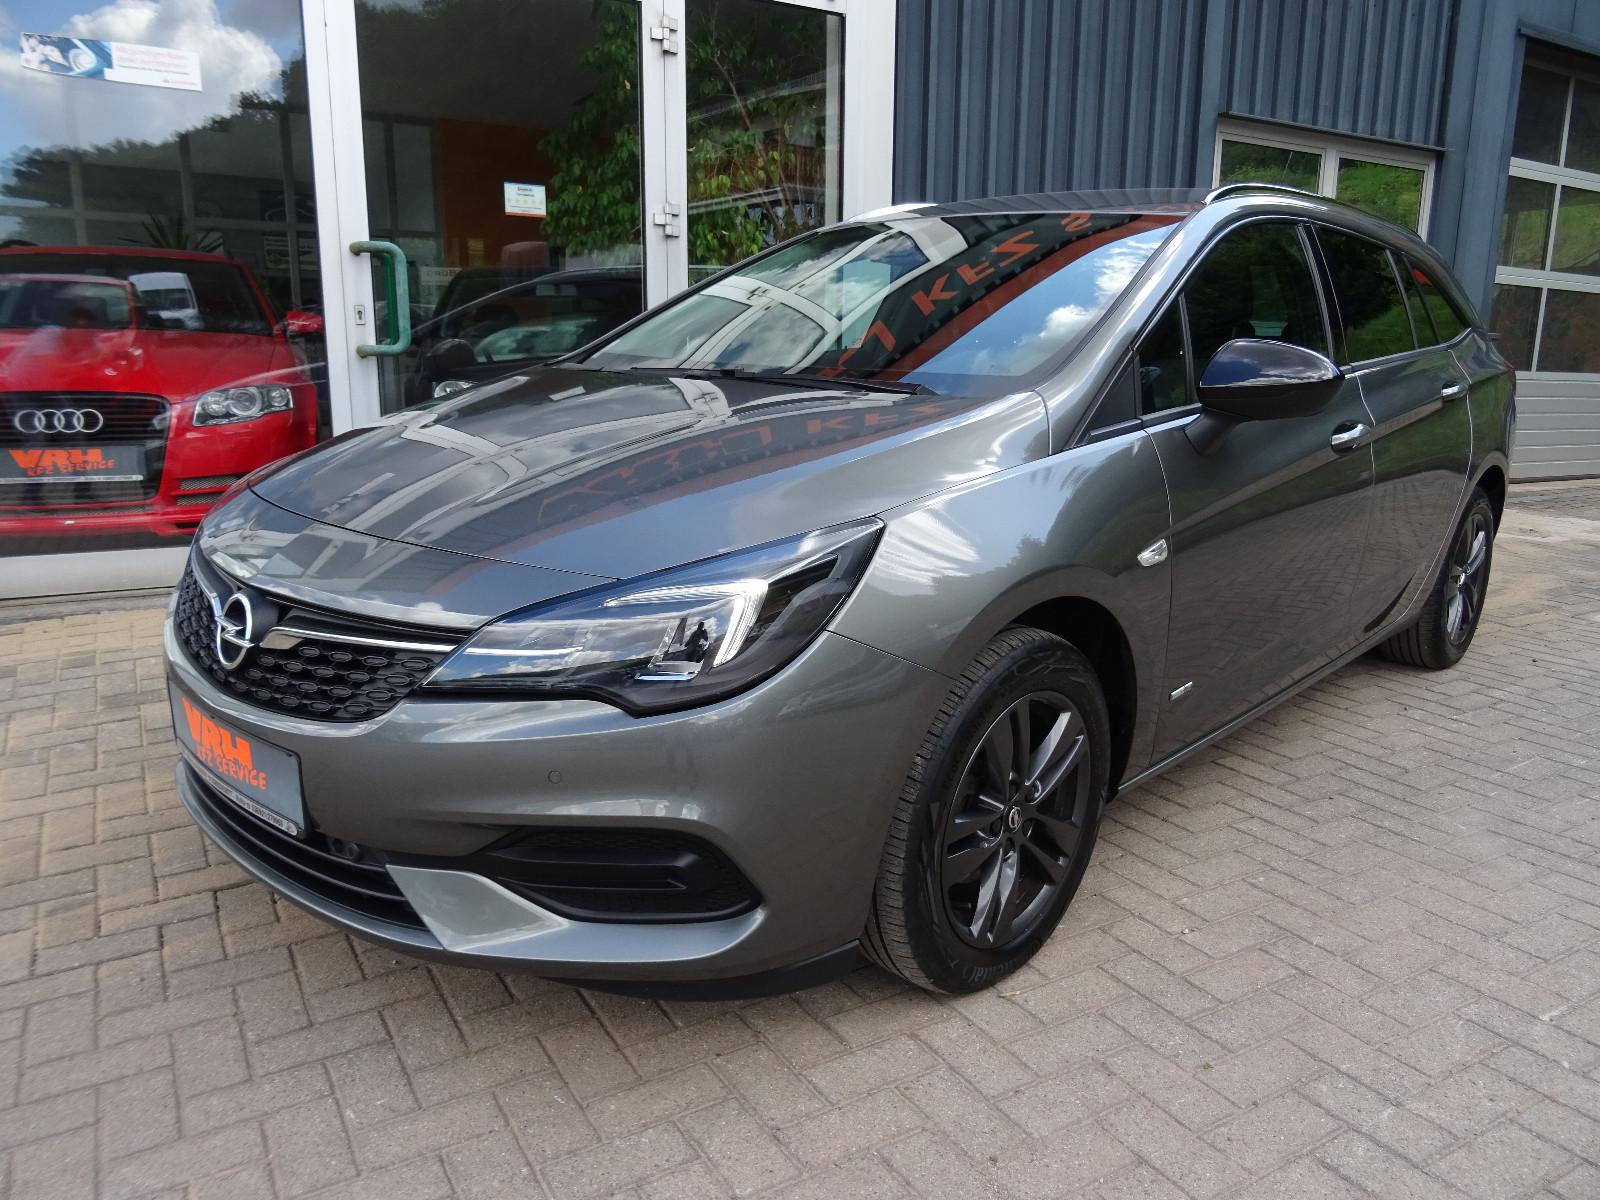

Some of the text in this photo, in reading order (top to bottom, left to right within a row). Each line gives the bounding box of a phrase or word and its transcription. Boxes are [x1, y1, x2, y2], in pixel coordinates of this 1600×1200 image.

[7, 449, 103, 471] VRH
[182, 696, 254, 770] VRH
[216, 754, 267, 791] SERVICE
